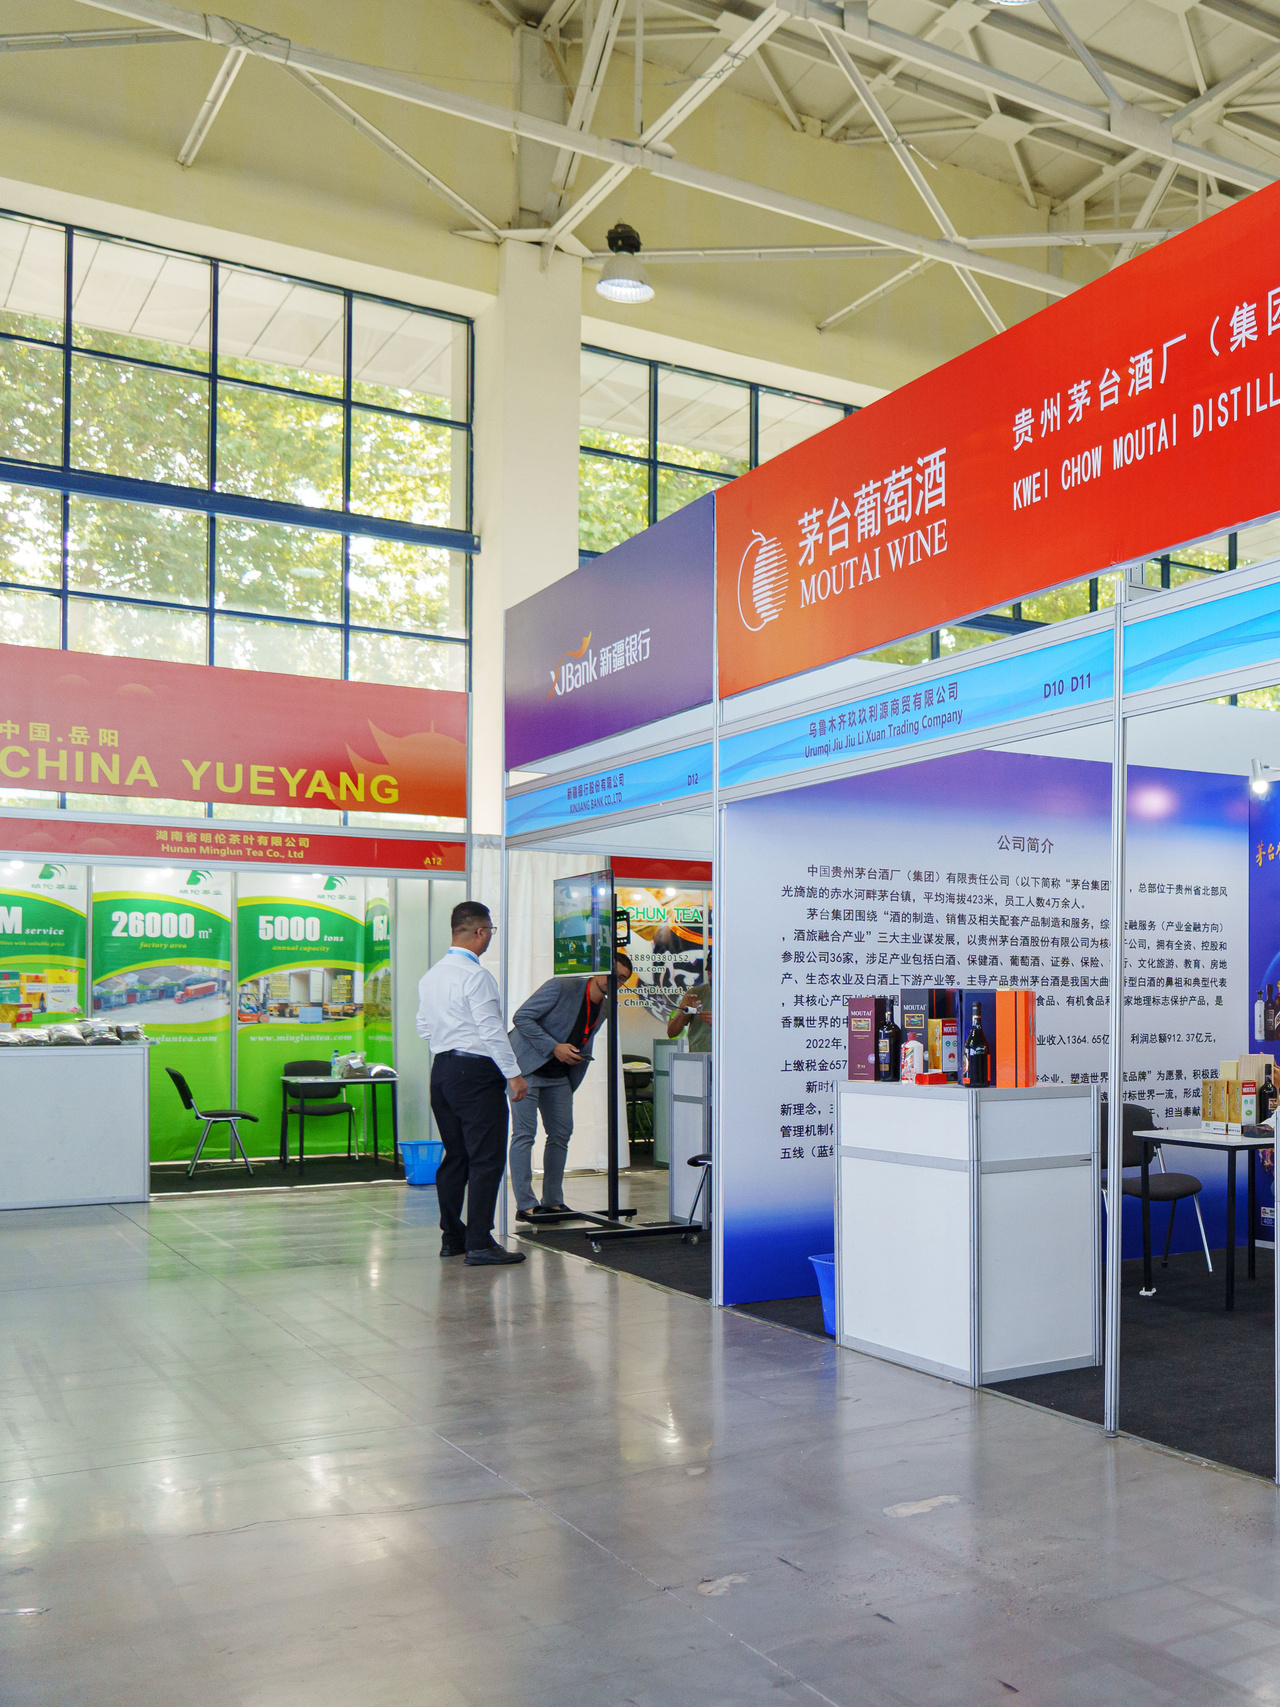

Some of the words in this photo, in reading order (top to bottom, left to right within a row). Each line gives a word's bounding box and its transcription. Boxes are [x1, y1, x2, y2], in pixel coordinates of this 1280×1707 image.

[1013, 469, 1048, 510] KWEI
[1061, 446, 1102, 491] CHOW
[1113, 412, 1177, 470] MOUTAI
[798, 447, 946, 566] 茅台葡萄酒
[800, 547, 881, 608] MOUTAI
[886, 519, 948, 569] WINE
[600, 628, 650, 677] 新疆银行
[1044, 678, 1064, 699] D10
[1071, 673, 1092, 693] D11
[808, 682, 958, 738] 乌鲁木齐玖玖利源商贸有限公司
[804, 740, 831, 758] Urumqi
[833, 737, 843, 752] Jiu
[844, 734, 856, 748] Jiu
[857, 731, 865, 745] Li
[866, 729, 886, 743] Xuan
[888, 719, 919, 736] Trading
[921, 709, 964, 729] Company
[0, 745, 159, 788] CHINA
[181, 759, 400, 804] YUEYANG
[687, 773, 699, 786] D12
[591, 796, 603, 809] BANK
[155, 830, 310, 848] 湖南省明伦茶叶有限公司
[997, 835, 1054, 854] 公司简介
[161, 843, 197, 855] Hunan
[199, 845, 244, 858] Minglun
[246, 847, 264, 858] Tea
[287, 849, 304, 859] Ltd
[424, 857, 443, 866] A12
[673, 907, 702, 921] TEA
[25, 927, 65, 936] service
[111, 911, 195, 938] 26000
[258, 915, 320, 941] 5000
[139, 941, 168, 950] factory
[300, 945, 330, 953] capacity
[629, 954, 689, 962] 18890380152
[633, 965, 666, 973] na.com
[149, 1034, 217, 1044] ngluntea.com
